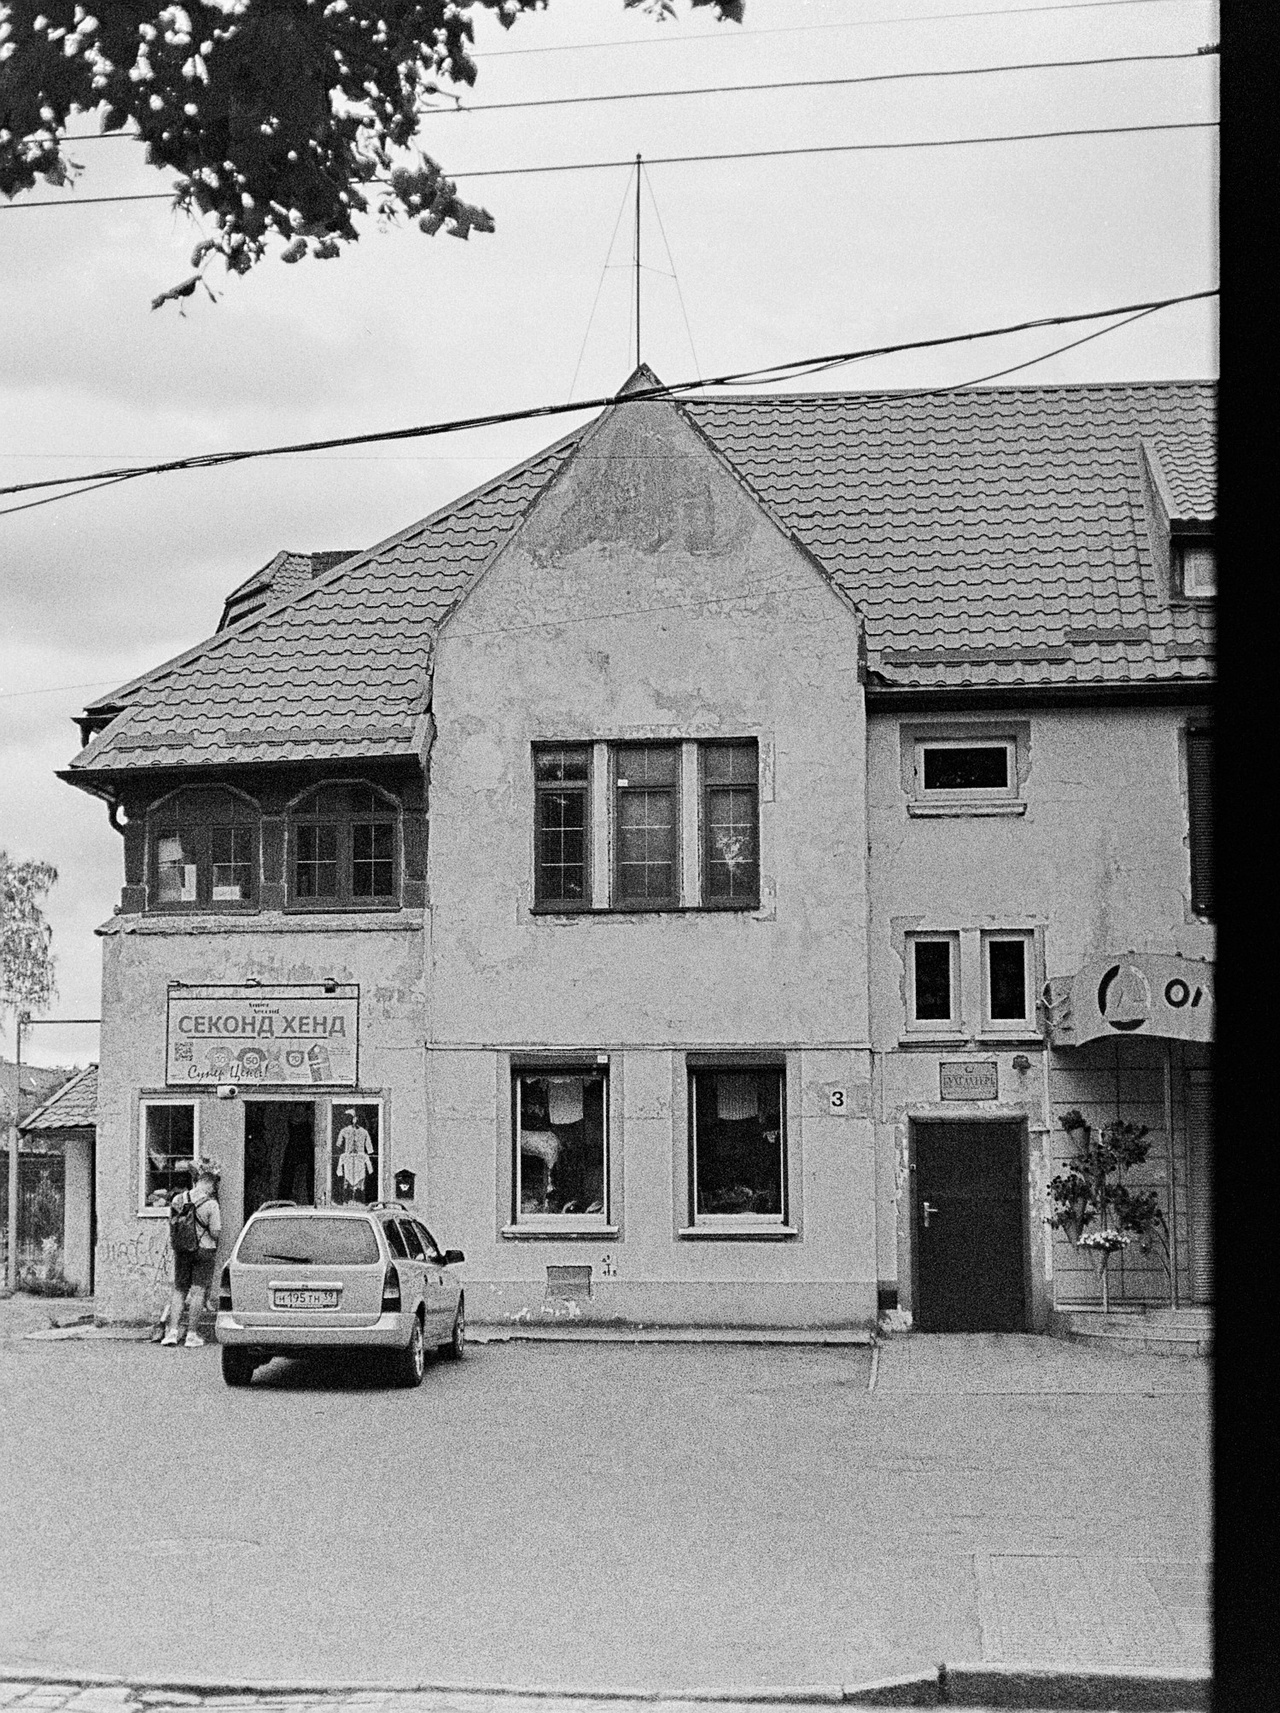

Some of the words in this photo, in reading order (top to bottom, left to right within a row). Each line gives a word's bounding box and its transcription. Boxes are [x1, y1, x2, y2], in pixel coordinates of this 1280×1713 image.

[178, 1015, 275, 1037] СЕКОНД
[281, 1015, 346, 1037] ХЕНД
[187, 1064, 225, 1082] Супер
[831, 1091, 844, 1107] 3
